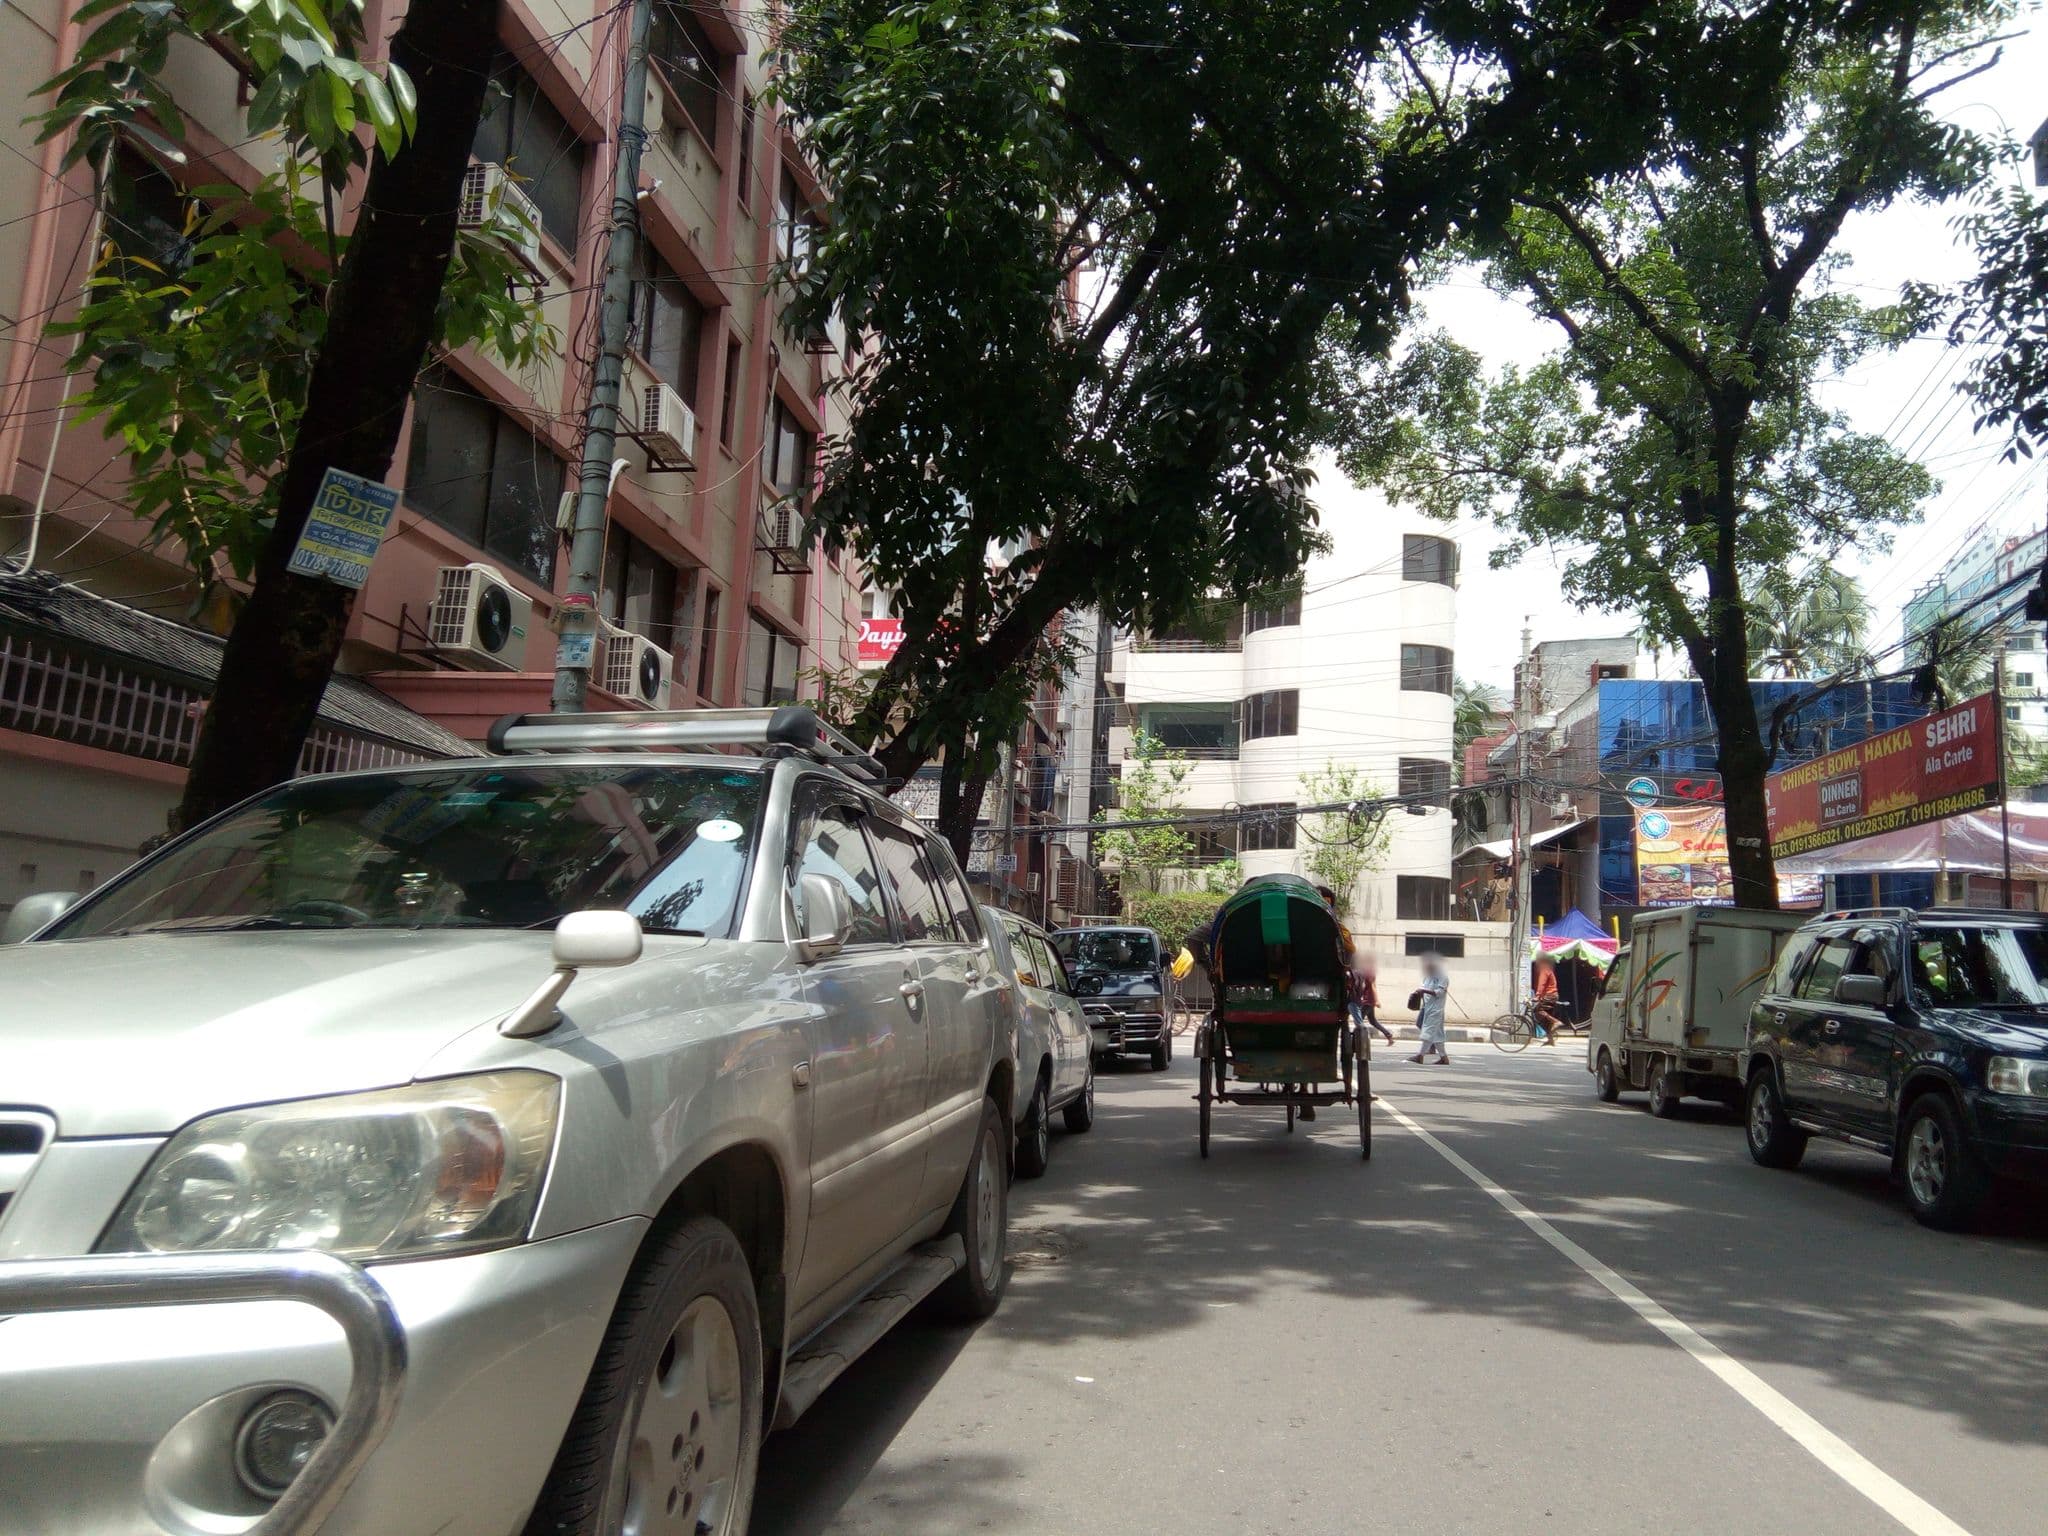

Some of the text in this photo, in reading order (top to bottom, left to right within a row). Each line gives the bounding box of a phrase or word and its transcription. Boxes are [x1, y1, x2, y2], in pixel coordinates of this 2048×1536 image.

[323, 484, 390, 525] টিচার
[1925, 709, 1978, 748] SEHRI
[1780, 729, 1913, 793] CHINESE BOWL HAKKA
[1924, 746, 1973, 775] Ala Carte
[1821, 779, 1858, 803] DINNER
[1911, 787, 1986, 822] 01918844886
[1824, 803, 1857, 818] Ala Carte
